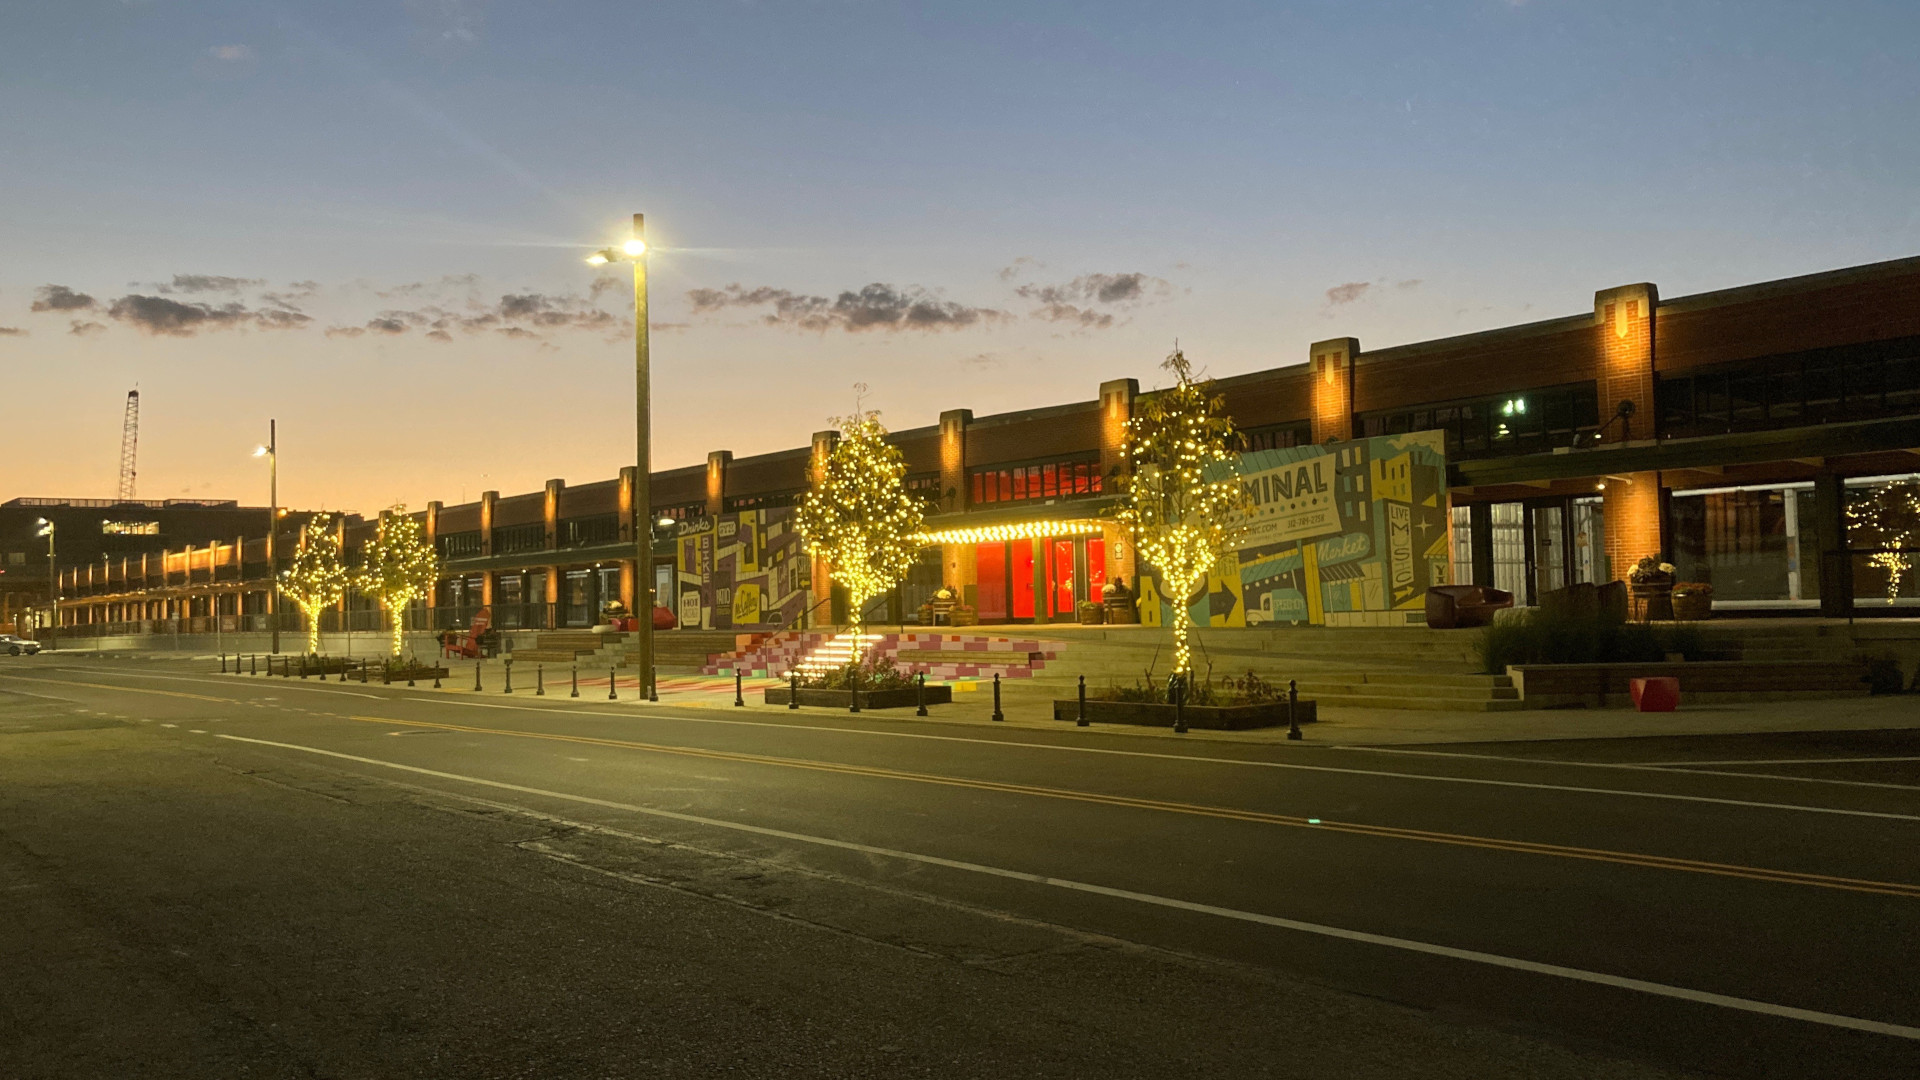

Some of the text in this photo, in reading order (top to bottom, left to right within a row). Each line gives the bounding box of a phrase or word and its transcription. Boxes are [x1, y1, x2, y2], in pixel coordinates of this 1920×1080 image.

[1391, 505, 1409, 522] LIVE
[678, 518, 711, 536] Drinks
[1317, 535, 1367, 561] Market
[1391, 521, 1412, 583] MUSIC
[702, 537, 711, 583] BIKE
[683, 598, 699, 608] HOT
